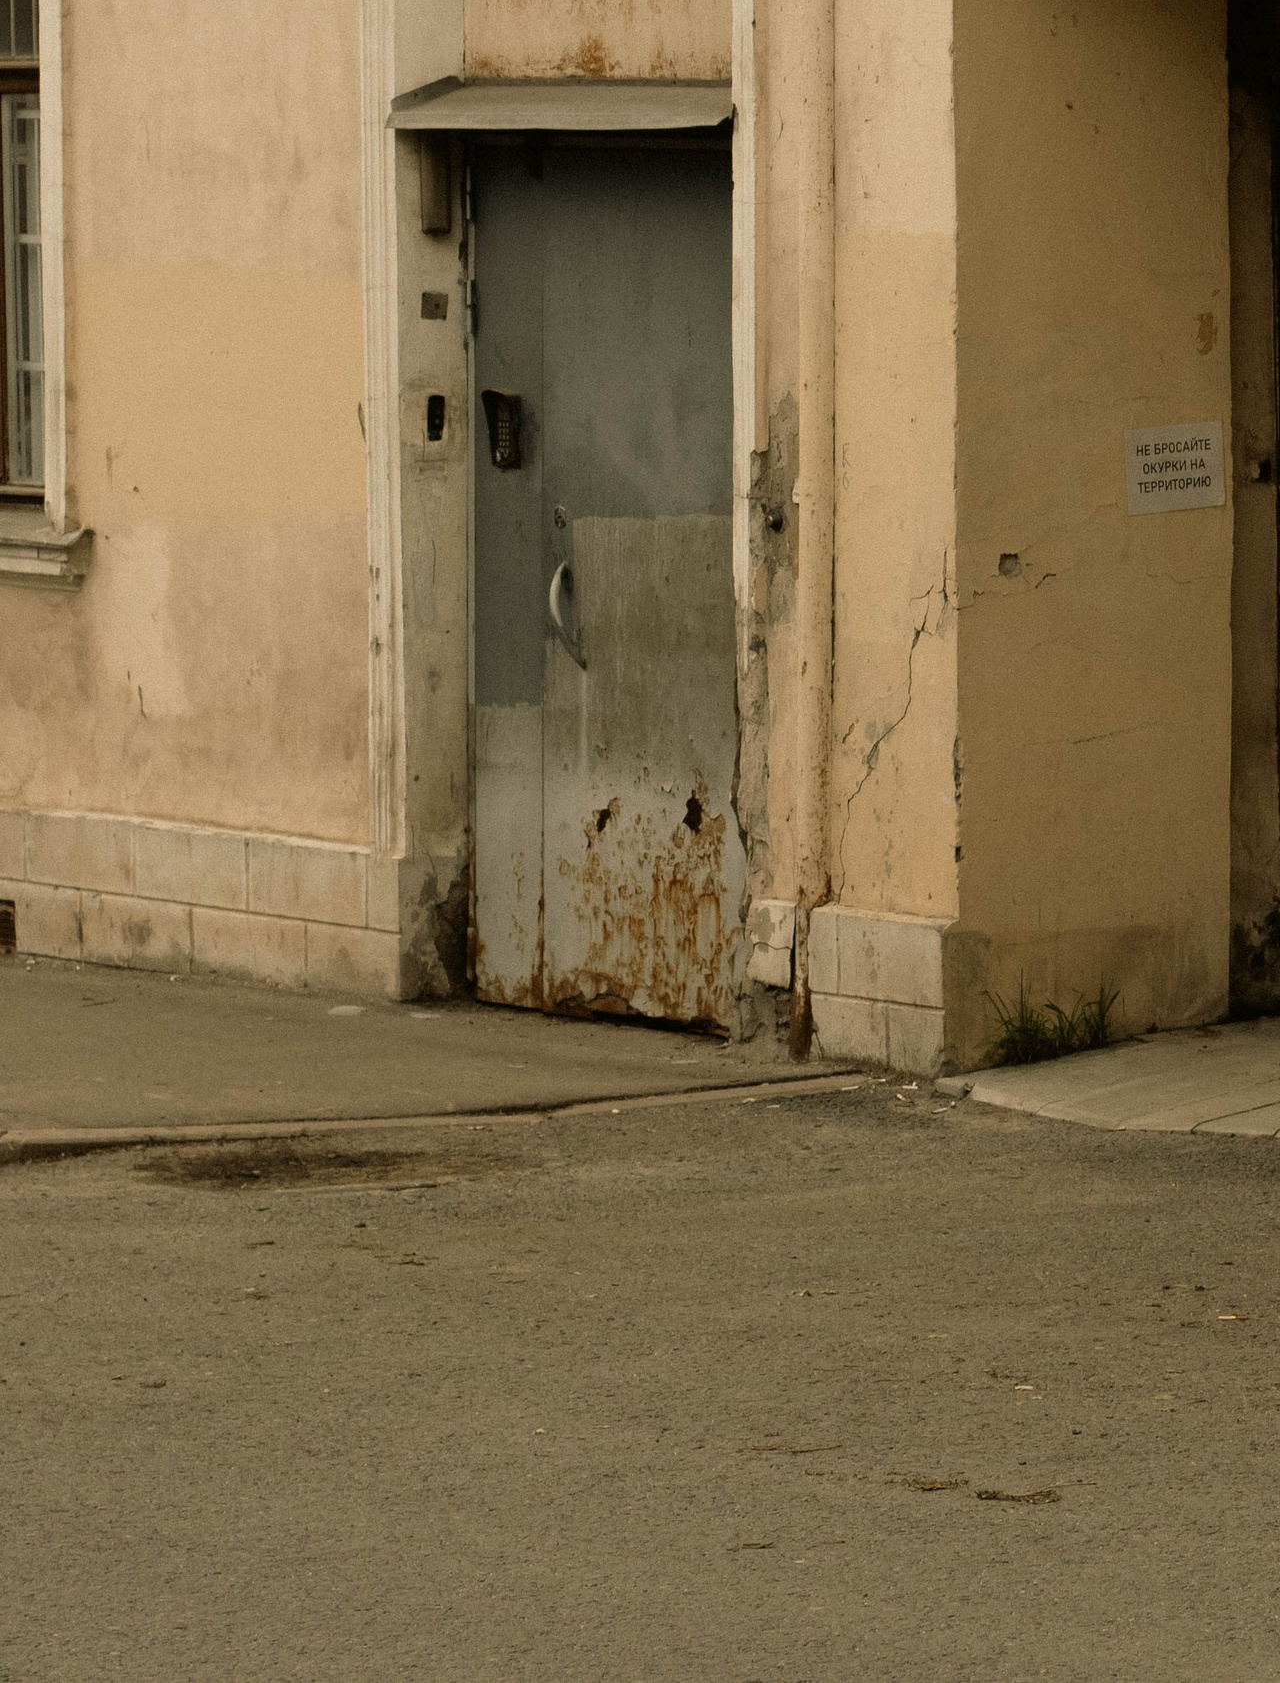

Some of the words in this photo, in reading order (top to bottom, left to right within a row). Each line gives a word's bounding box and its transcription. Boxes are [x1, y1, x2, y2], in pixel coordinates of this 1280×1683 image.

[1136, 444, 1151, 456] НЕ
[1154, 437, 1211, 455] БРОСАЙТЕ
[1142, 460, 1187, 475] ОКУРКИ
[1190, 457, 1206, 470] НА
[1137, 475, 1212, 494] ТЕРРИТОРИЮ
